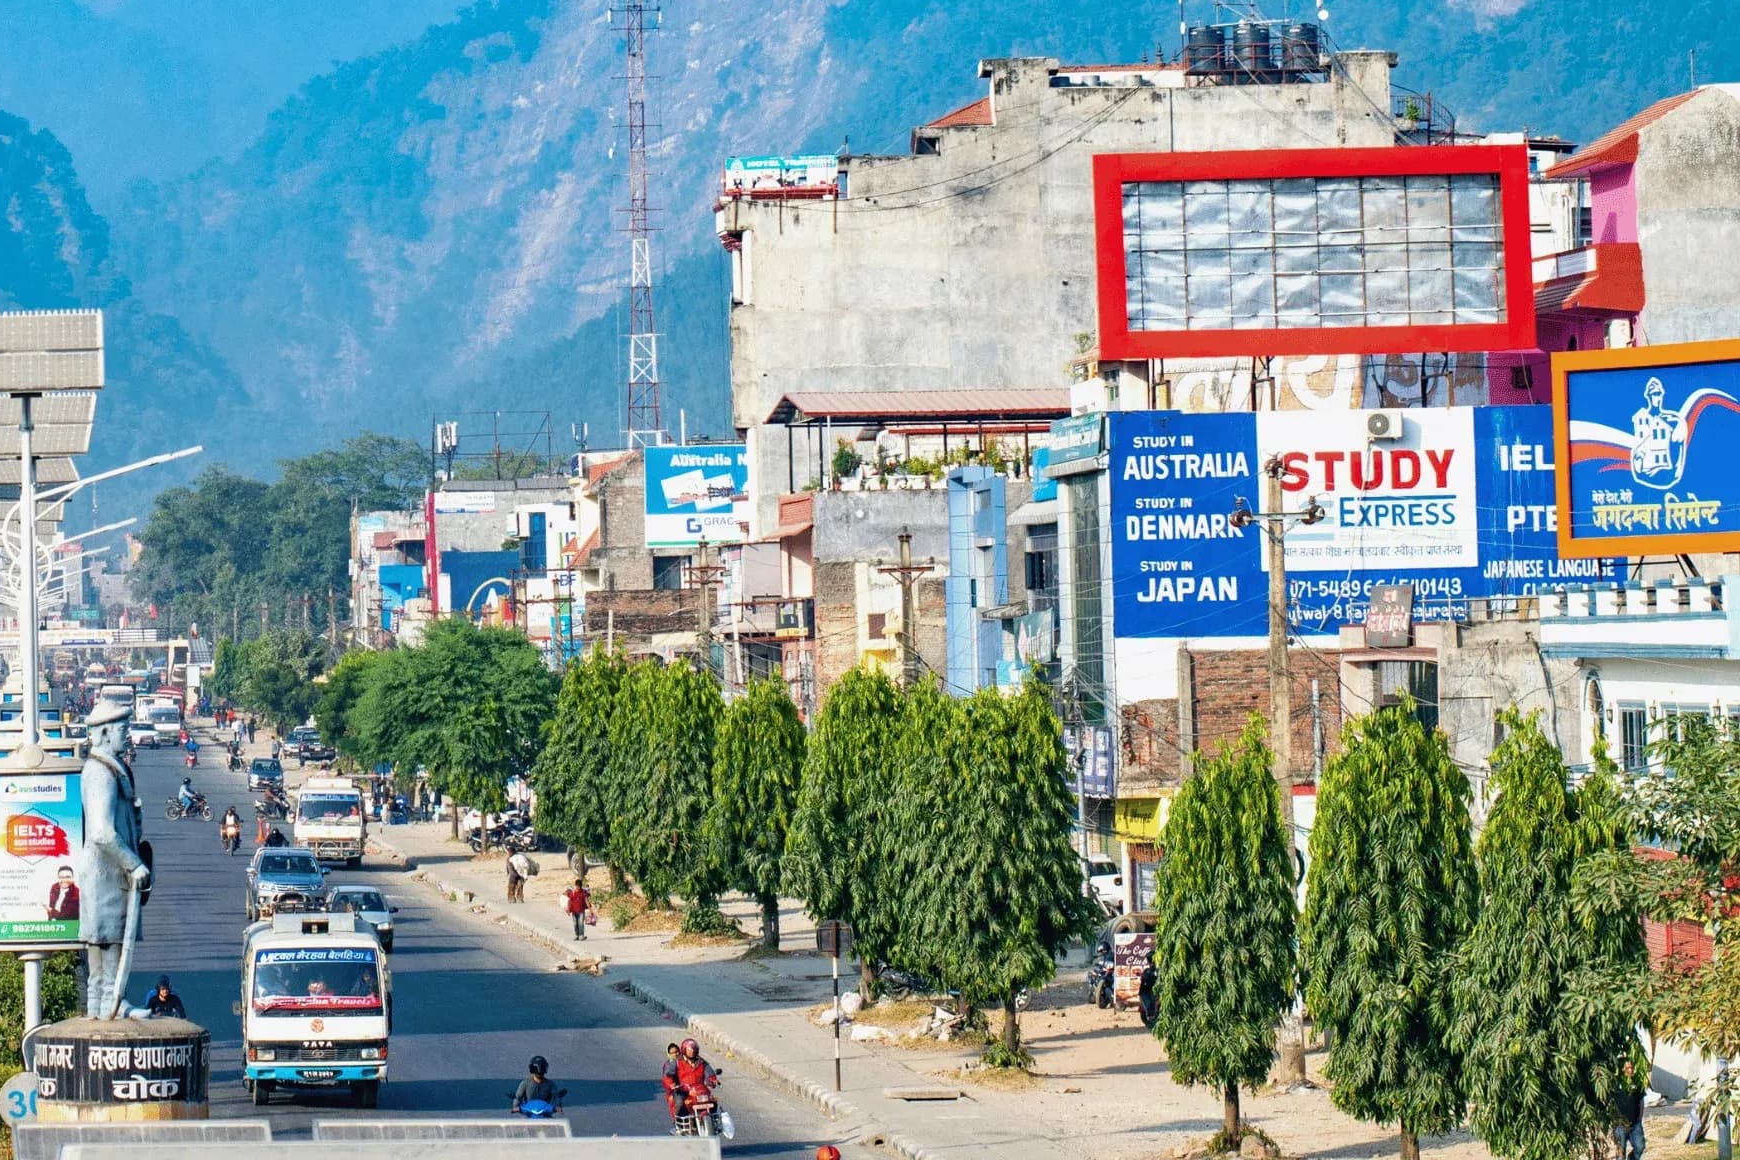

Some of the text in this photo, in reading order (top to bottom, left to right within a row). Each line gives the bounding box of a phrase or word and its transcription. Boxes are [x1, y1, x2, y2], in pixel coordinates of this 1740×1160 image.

[1133, 435, 1194, 448] STUDY IN
[1123, 451, 1250, 481] AUSTRALIA
[1281, 449, 1455, 492] STUDY
[1500, 444, 1556, 471] IEL
[1135, 497, 1192, 509] STUDY IN
[1592, 492, 1721, 532] जगदम्बा सिमेन्ट
[1126, 513, 1244, 541] DENMARK
[1140, 560, 1193, 572] STUDY IN
[1483, 558, 1616, 579] JAPANESE LANGUAGE
[1137, 576, 1238, 602] JAPAN
[13, 824, 55, 837] IELTS
[1132, 944, 1151, 957] Coff
[303, 1040, 333, 1048] TATA
[88, 1045, 131, 1071] लखन
[112, 1074, 181, 1100] चोक
